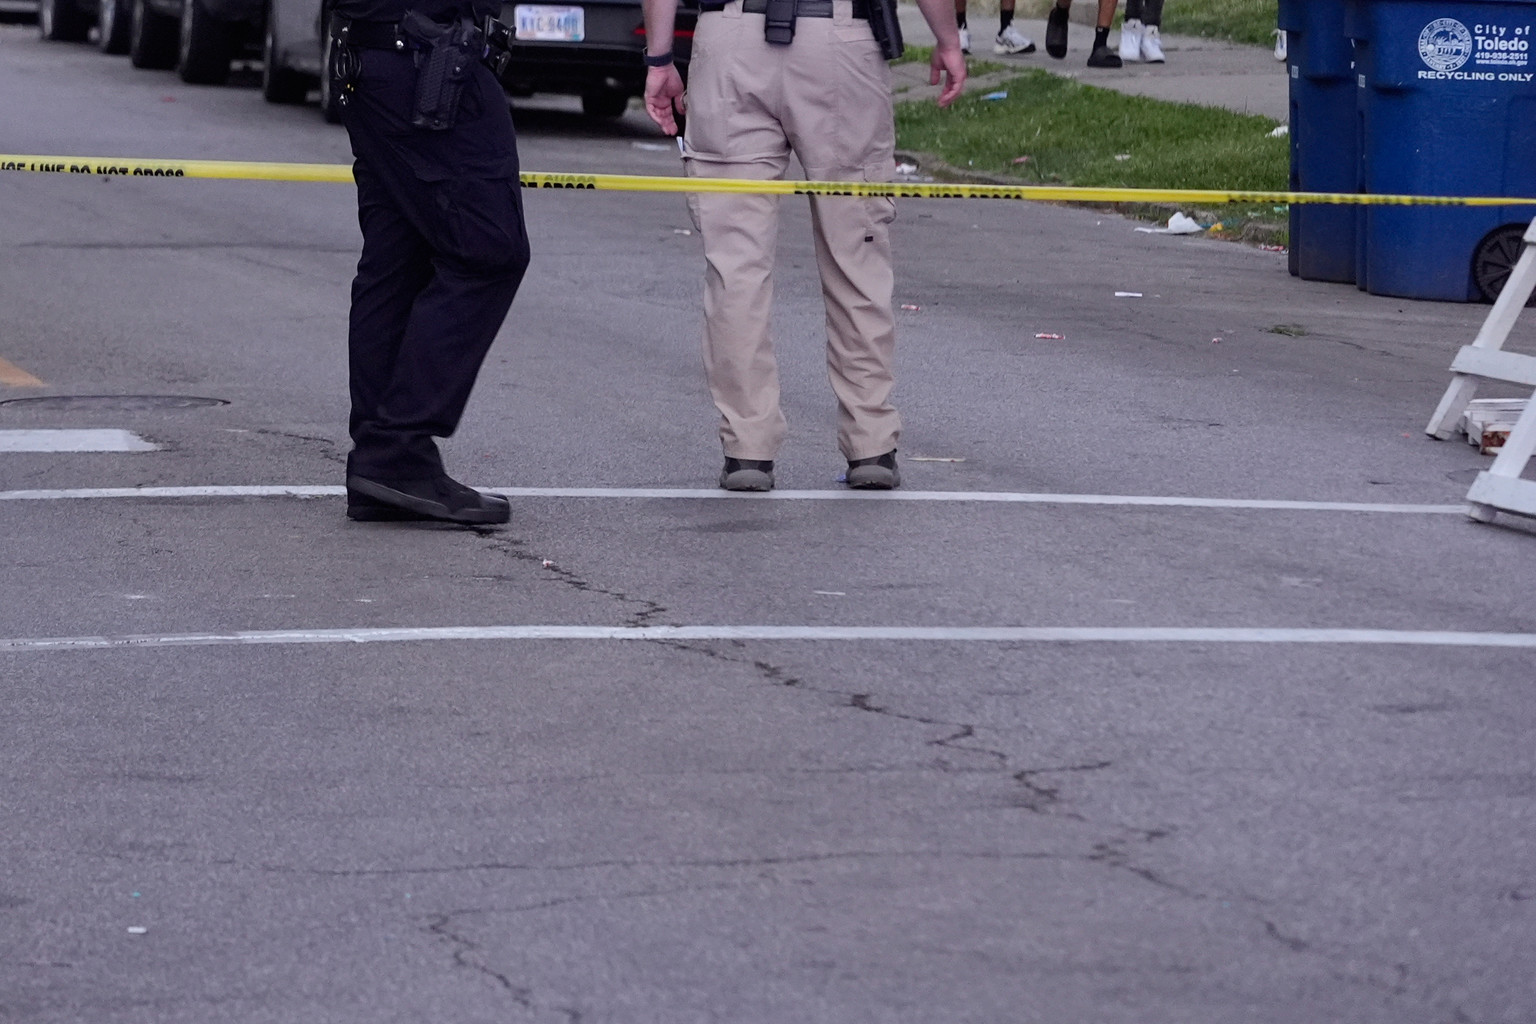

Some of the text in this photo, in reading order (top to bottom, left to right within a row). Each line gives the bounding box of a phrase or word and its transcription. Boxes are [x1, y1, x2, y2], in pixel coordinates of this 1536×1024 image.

[1474, 24, 1530, 36] City of
[1474, 36, 1529, 51] Toledo
[1418, 71, 1534, 81] RECYCLING ONLY
